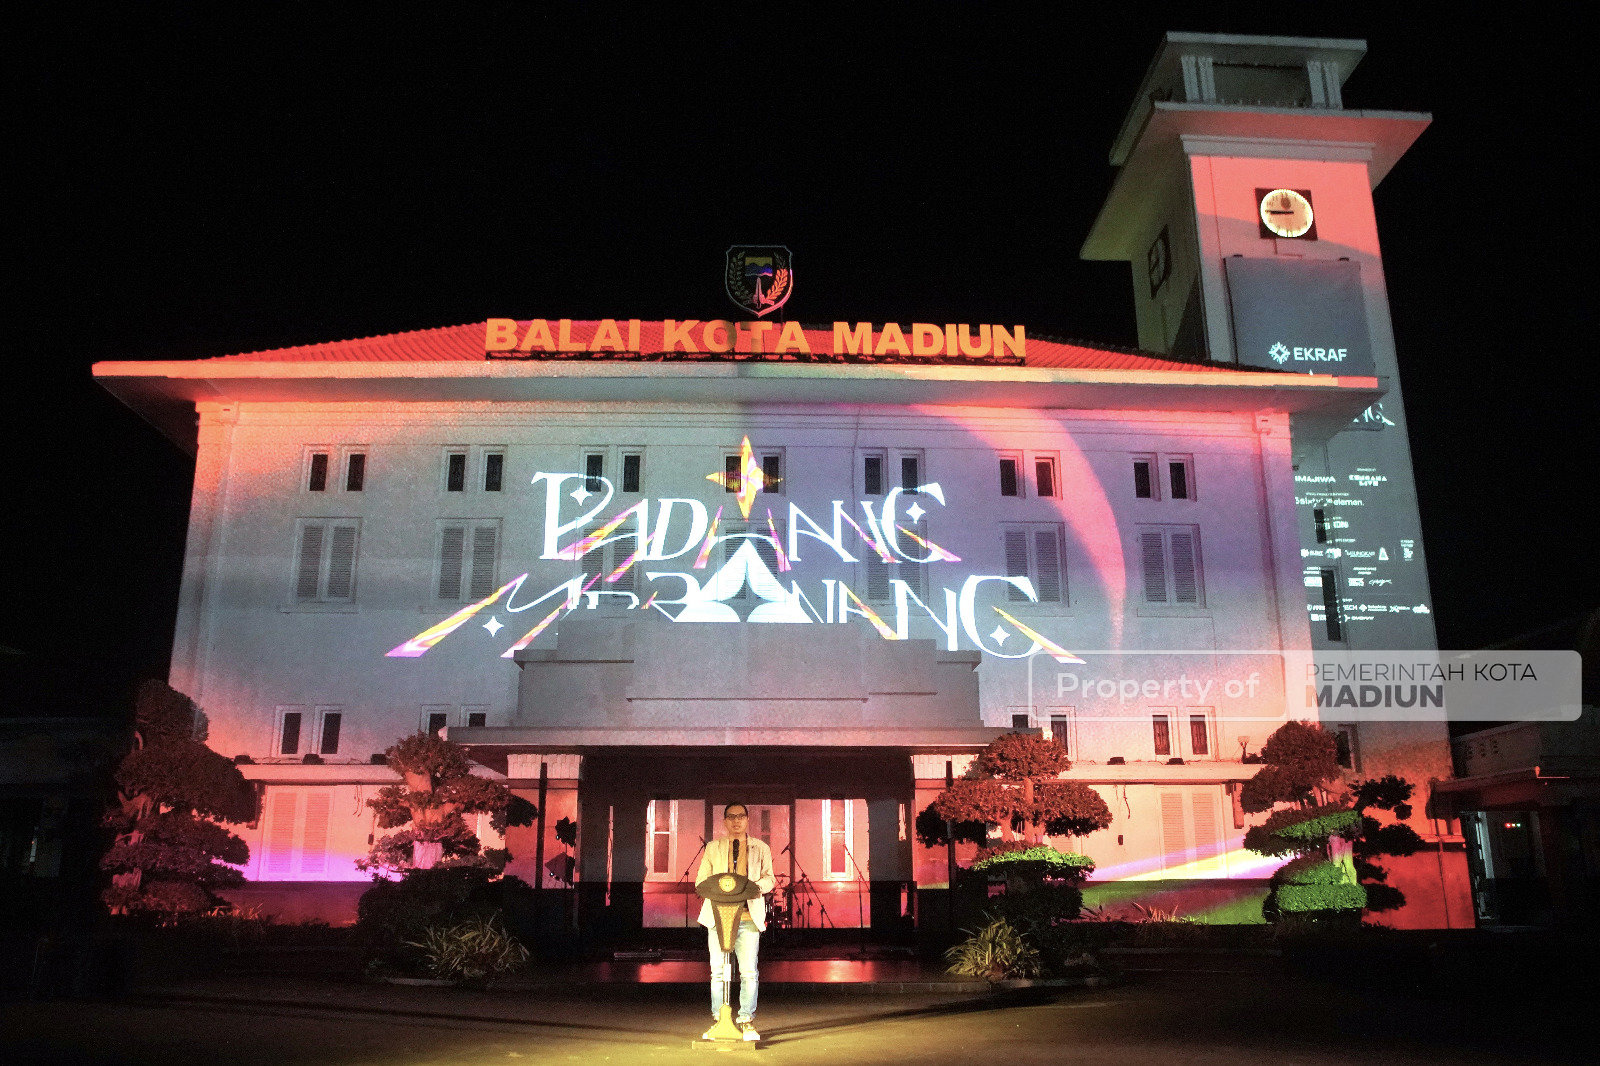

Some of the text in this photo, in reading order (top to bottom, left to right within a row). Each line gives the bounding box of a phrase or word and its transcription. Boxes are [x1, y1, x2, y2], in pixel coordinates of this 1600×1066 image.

[484, 317, 1027, 359] BALAI KOTA MADIUN
[1293, 346, 1348, 362] EKRAF
